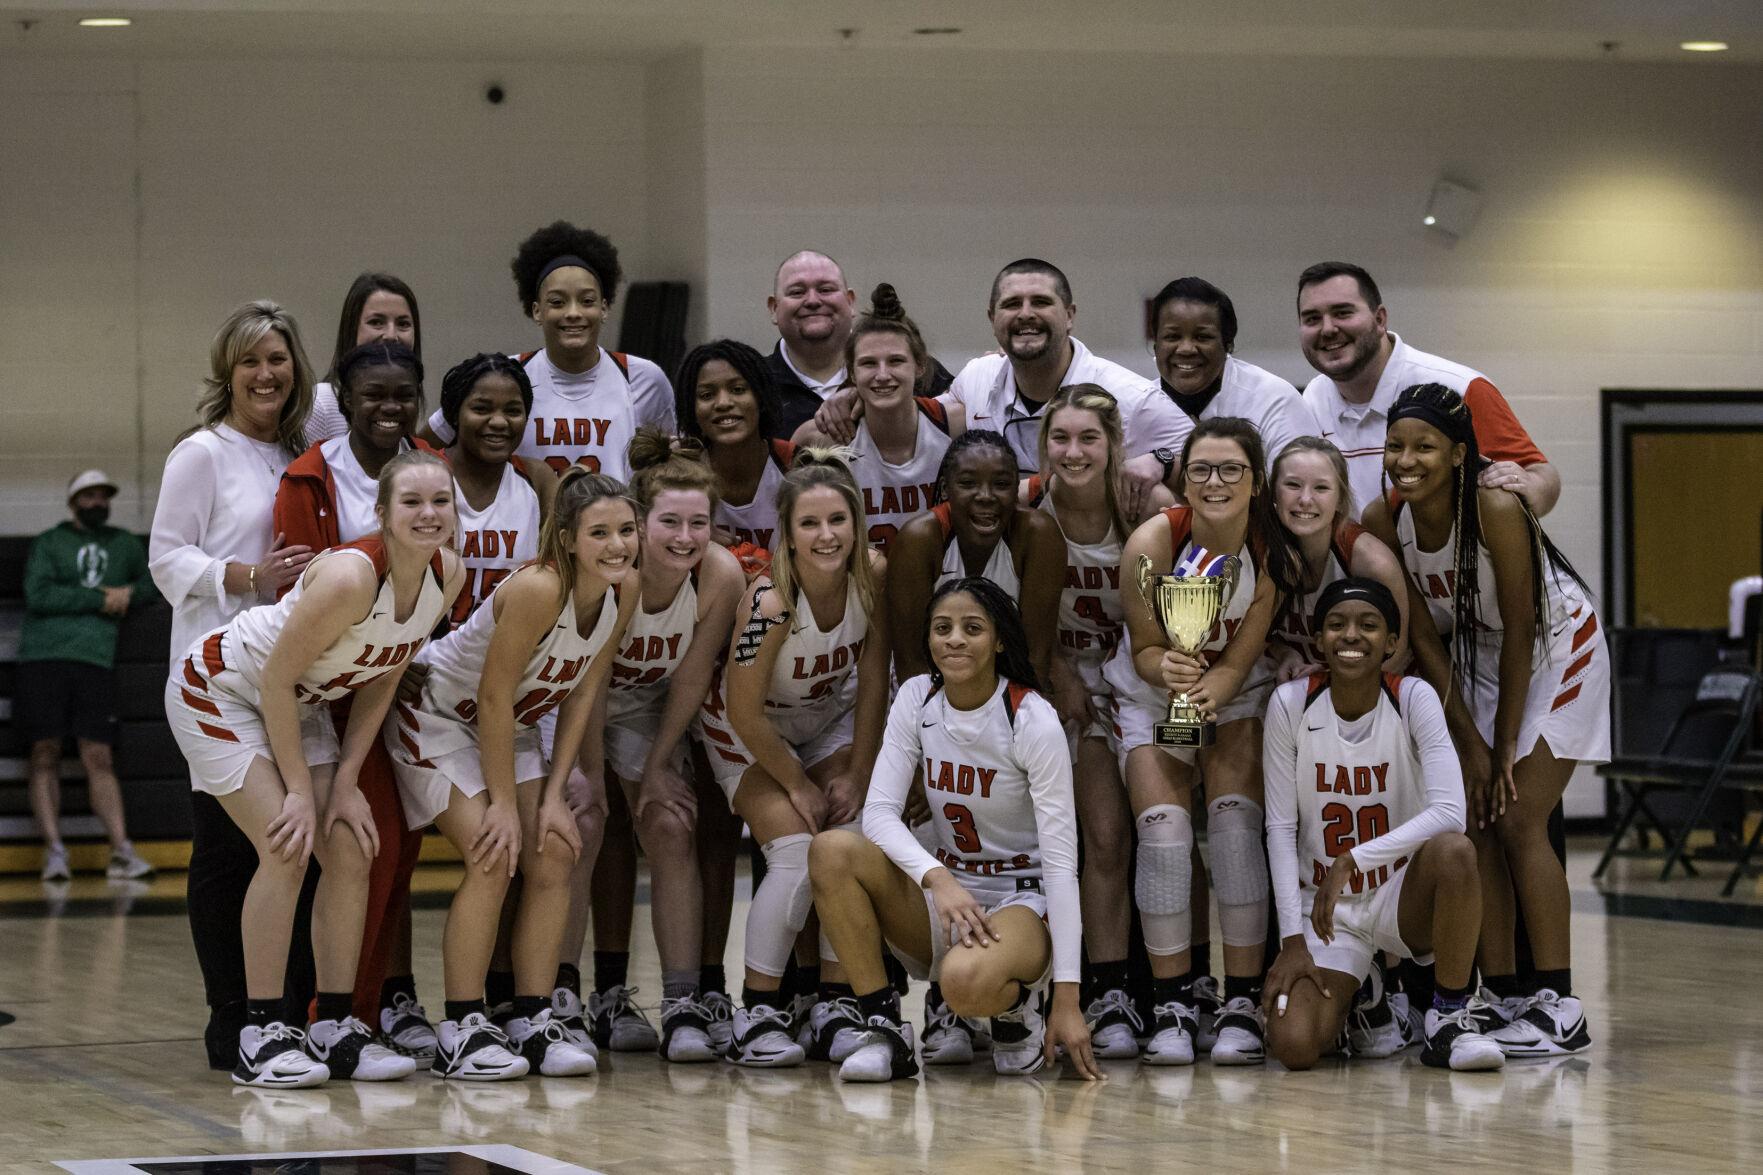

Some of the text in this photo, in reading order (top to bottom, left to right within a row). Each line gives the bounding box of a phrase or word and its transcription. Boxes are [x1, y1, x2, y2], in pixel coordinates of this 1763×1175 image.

[534, 417, 612, 447] LADY
[862, 481, 938, 516] LADY
[461, 529, 519, 559] ADY
[1063, 565, 1121, 590] ADY
[617, 632, 683, 662] ADY
[926, 757, 998, 799] LADY
[1315, 761, 1390, 797] LADY
[942, 802, 983, 854] 3
[1321, 801, 1390, 859] 20
